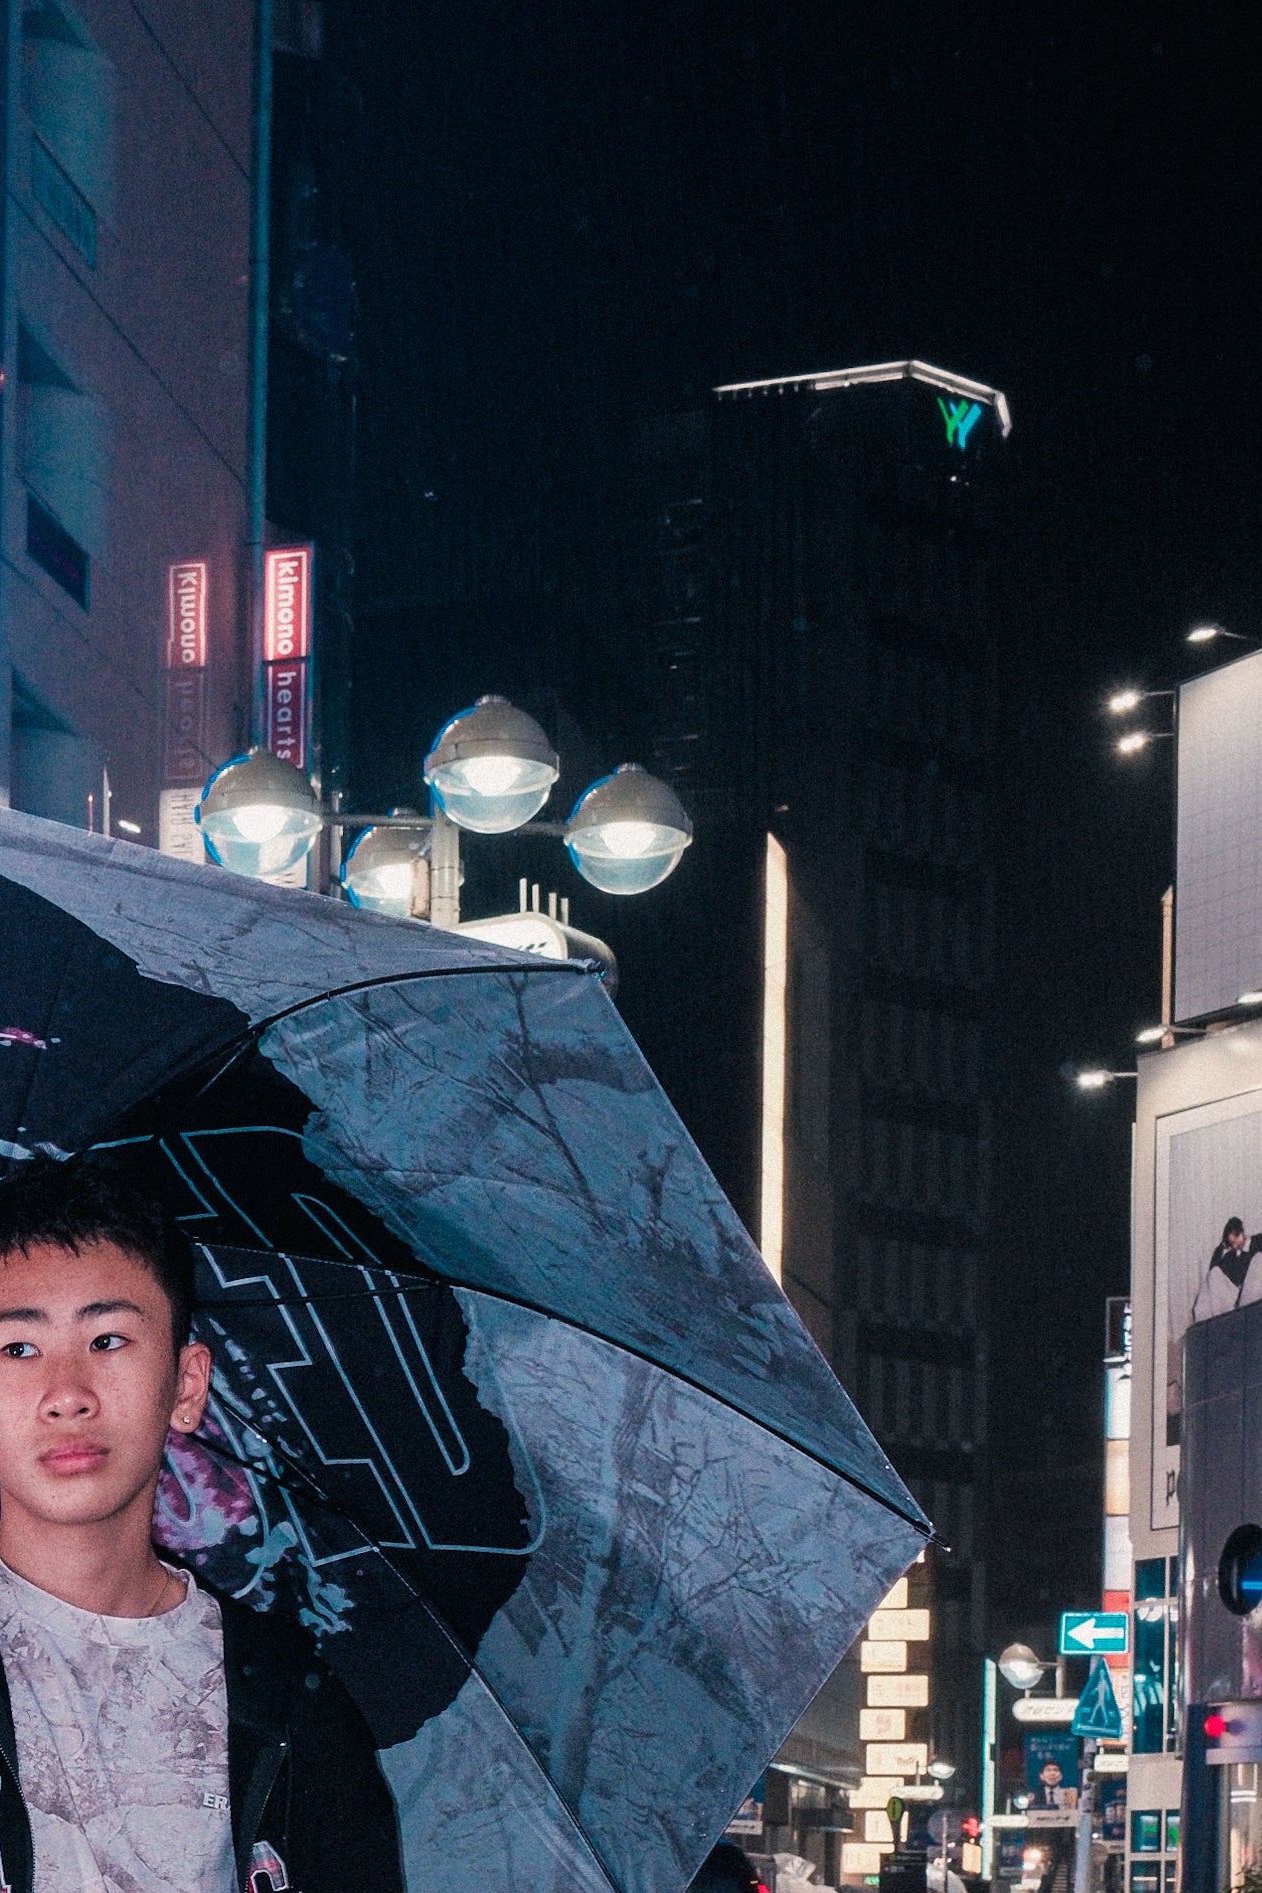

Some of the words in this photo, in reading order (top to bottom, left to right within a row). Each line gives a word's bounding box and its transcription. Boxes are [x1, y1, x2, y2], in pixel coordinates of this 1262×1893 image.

[276, 560, 299, 656] kimono
[276, 670, 297, 763] hearts
[202, 1792, 233, 1812] ER
